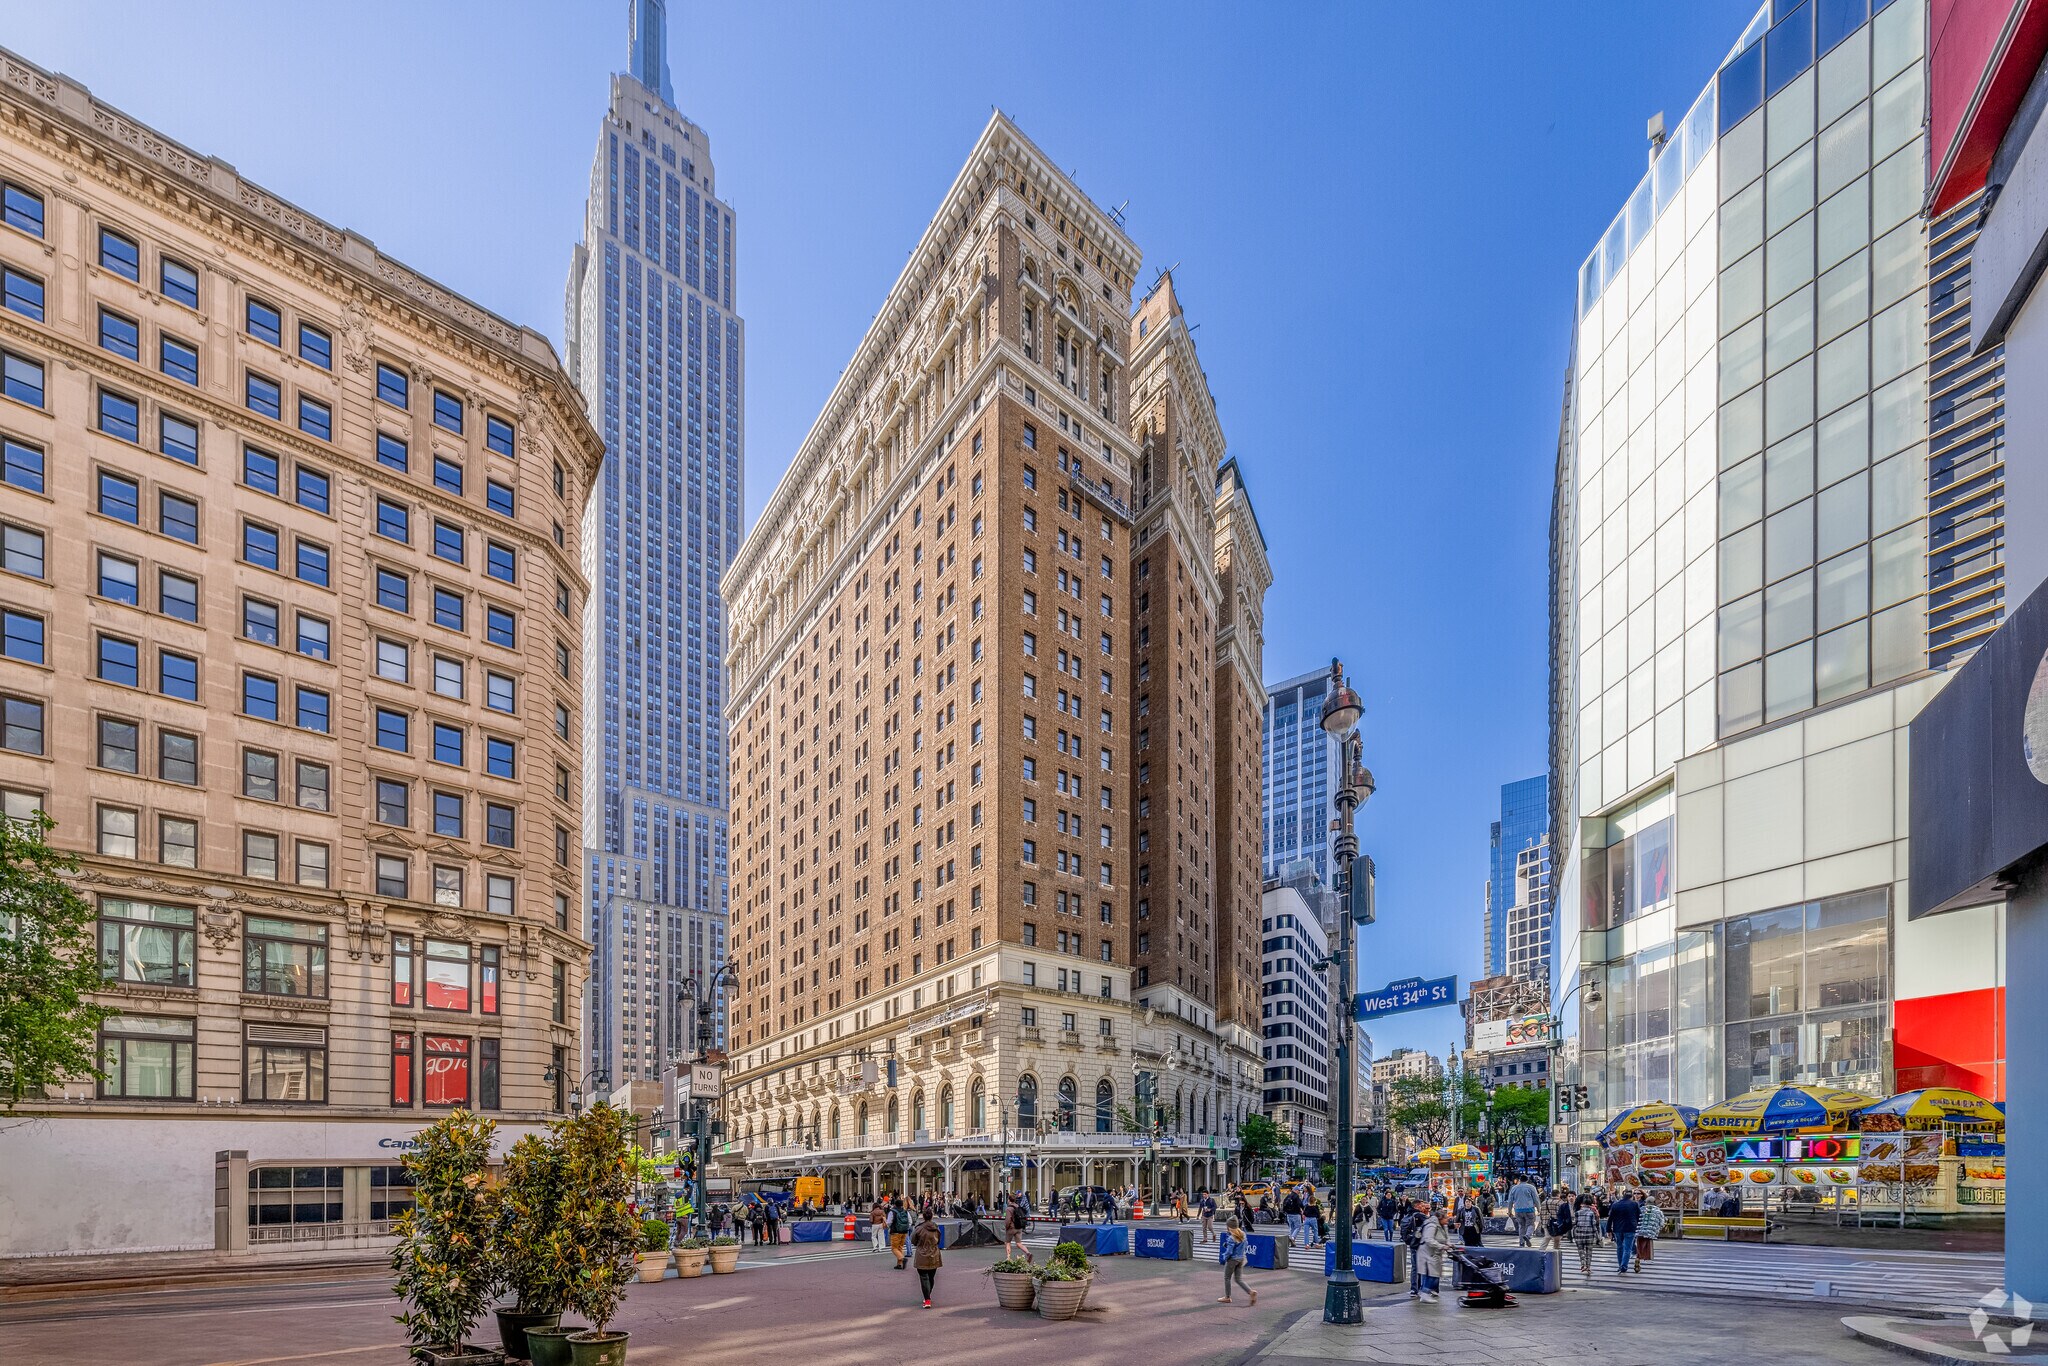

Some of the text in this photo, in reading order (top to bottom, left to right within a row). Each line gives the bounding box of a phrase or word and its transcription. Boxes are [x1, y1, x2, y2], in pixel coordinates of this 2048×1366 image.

[1364, 985, 1447, 1012] West 34th St
[699, 1070, 713, 1080] NO
[693, 1082, 718, 1093] TURNS
[1630, 1112, 1674, 1124] SABRETT
[1702, 1117, 1758, 1128] SABRETT
